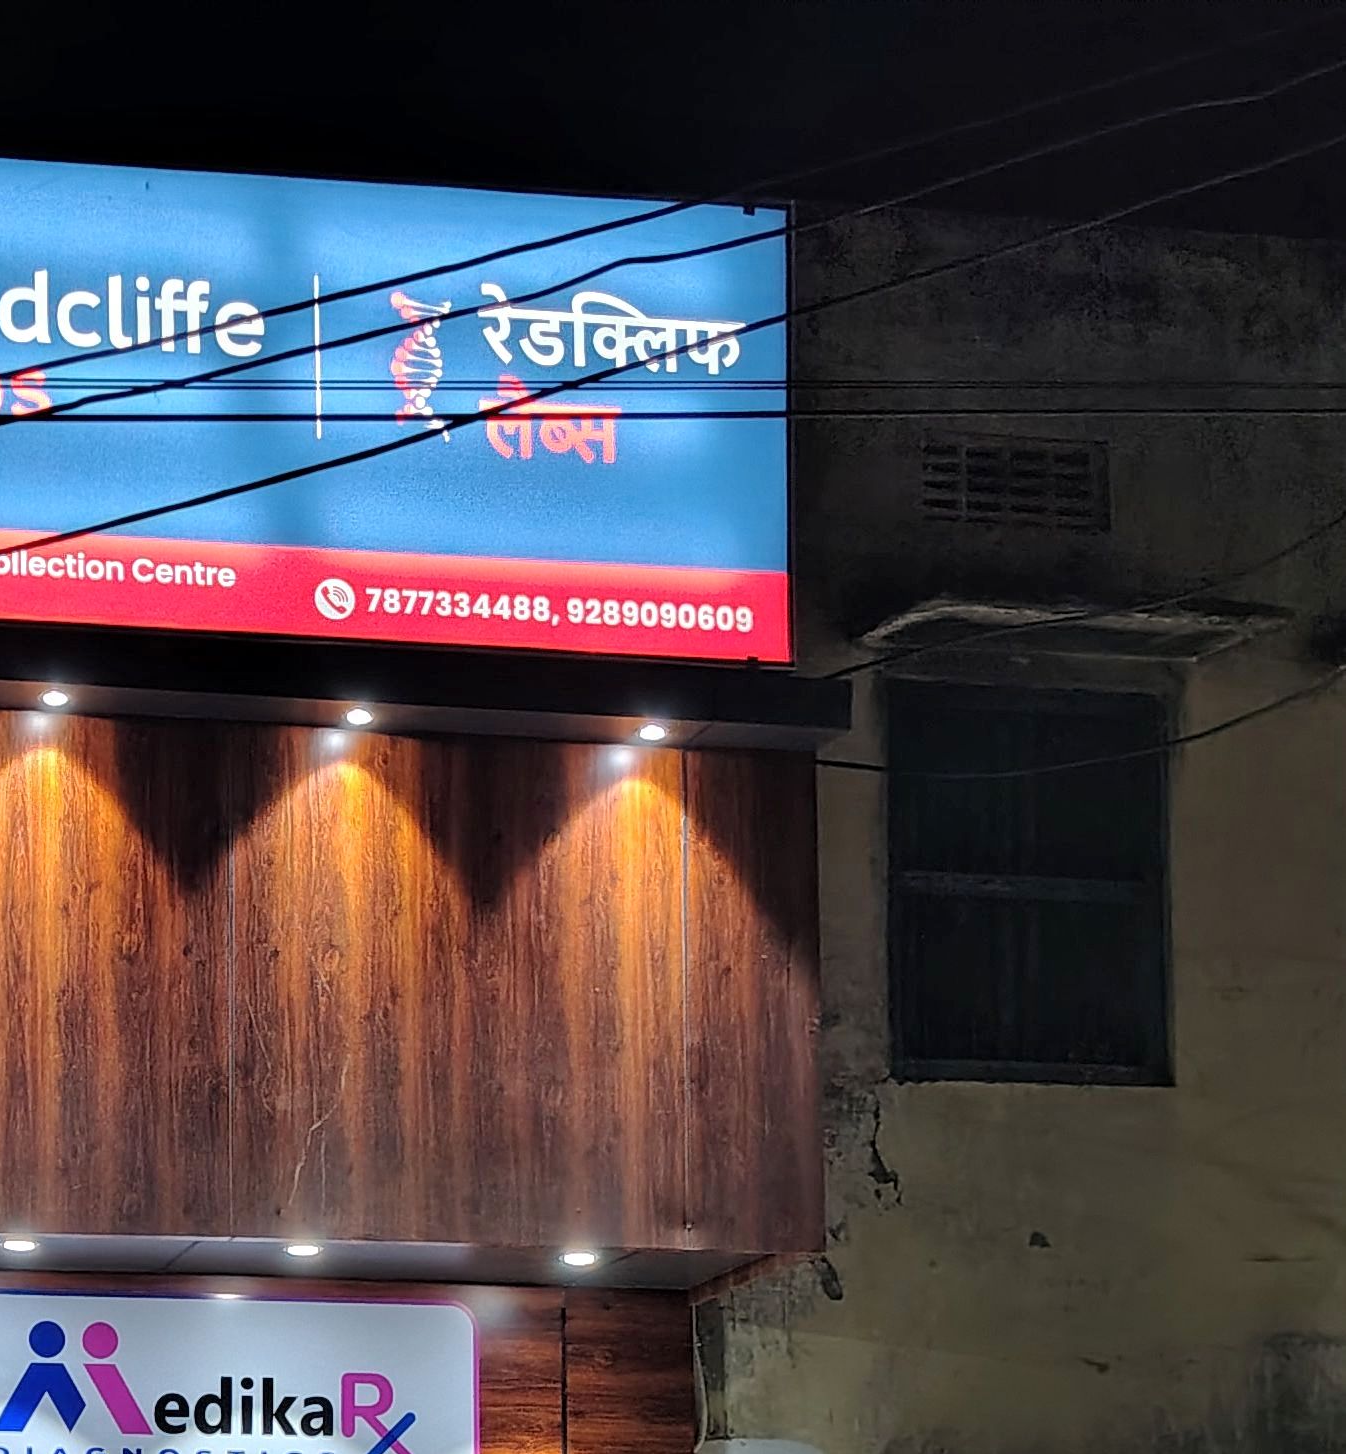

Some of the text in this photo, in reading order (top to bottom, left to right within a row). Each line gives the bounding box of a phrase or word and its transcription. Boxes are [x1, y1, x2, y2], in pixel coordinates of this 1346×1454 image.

[478, 283, 746, 375] रेडक्लिफ
[479, 374, 622, 464] लैब्स
[131, 556, 238, 589] Centre
[365, 587, 754, 634] 7877334488, 9289090609
